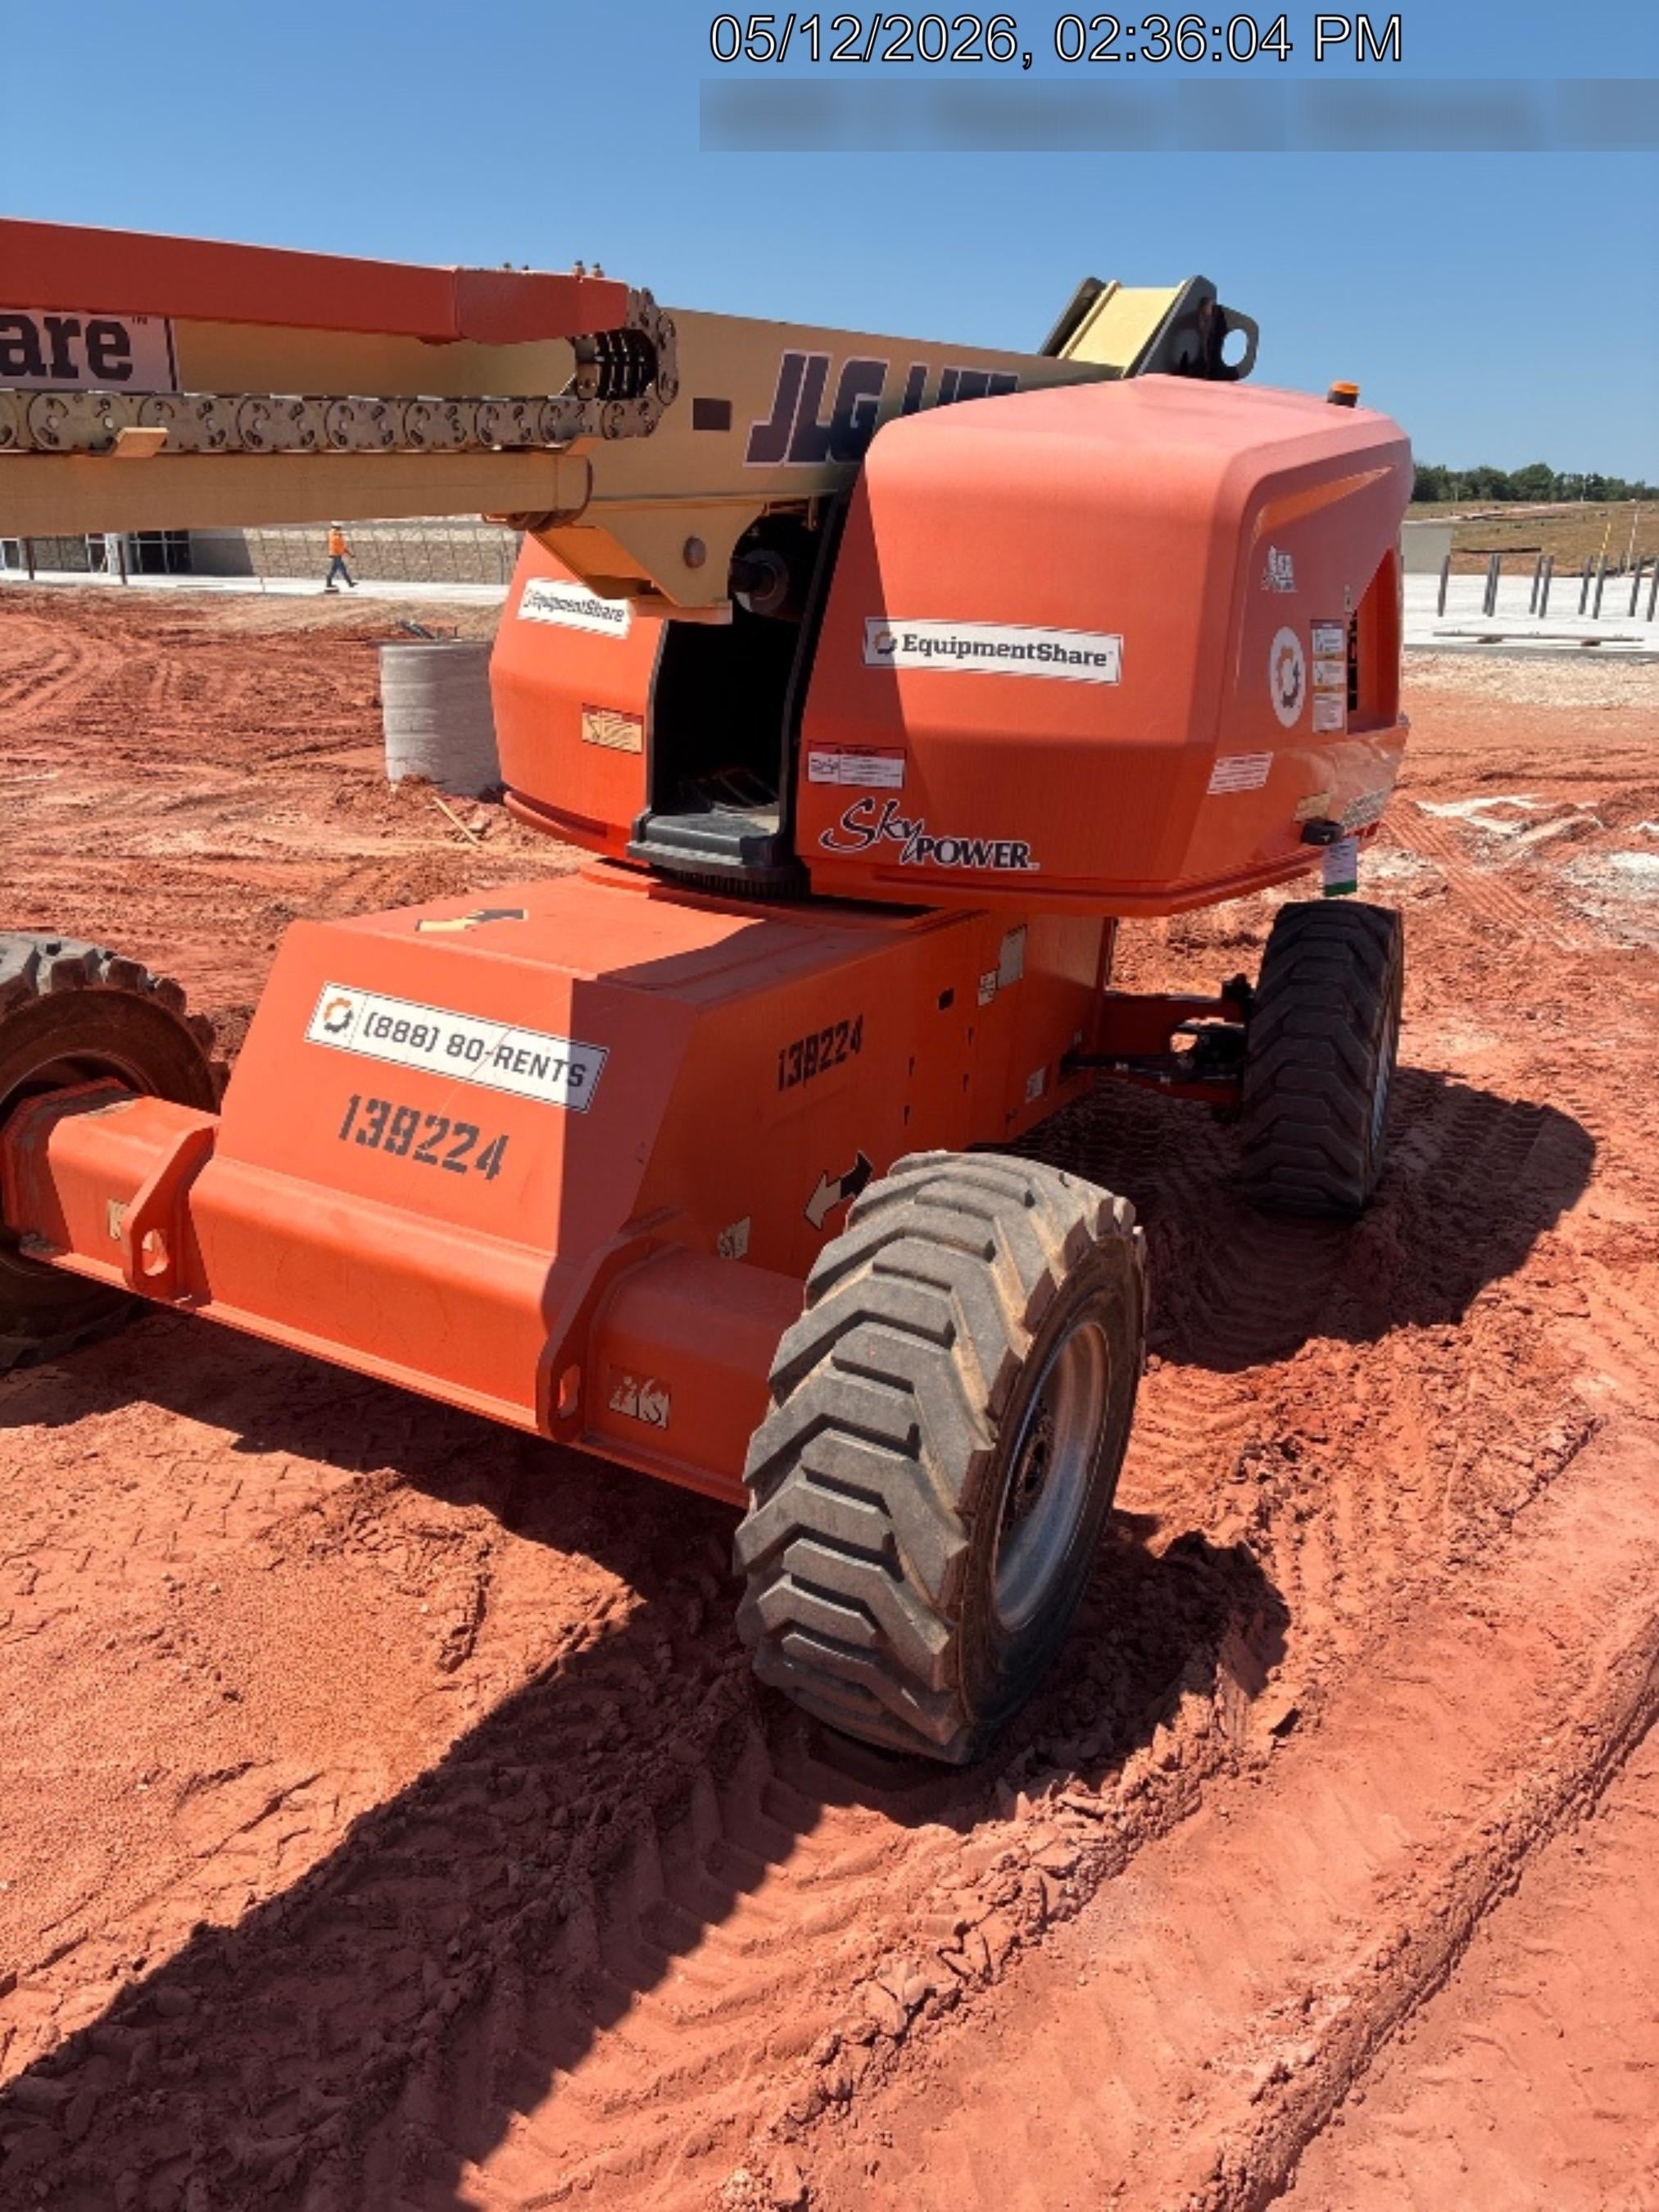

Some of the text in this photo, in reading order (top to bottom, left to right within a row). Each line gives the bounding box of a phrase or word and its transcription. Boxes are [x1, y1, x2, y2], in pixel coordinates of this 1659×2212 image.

[744, 349, 890, 467] JLG
[902, 634, 1108, 667] EquipmentShare
[915, 836, 1032, 869] POWER
[362, 1012, 588, 1088] (888) 80-RENTS
[338, 1094, 510, 1181] 139224
